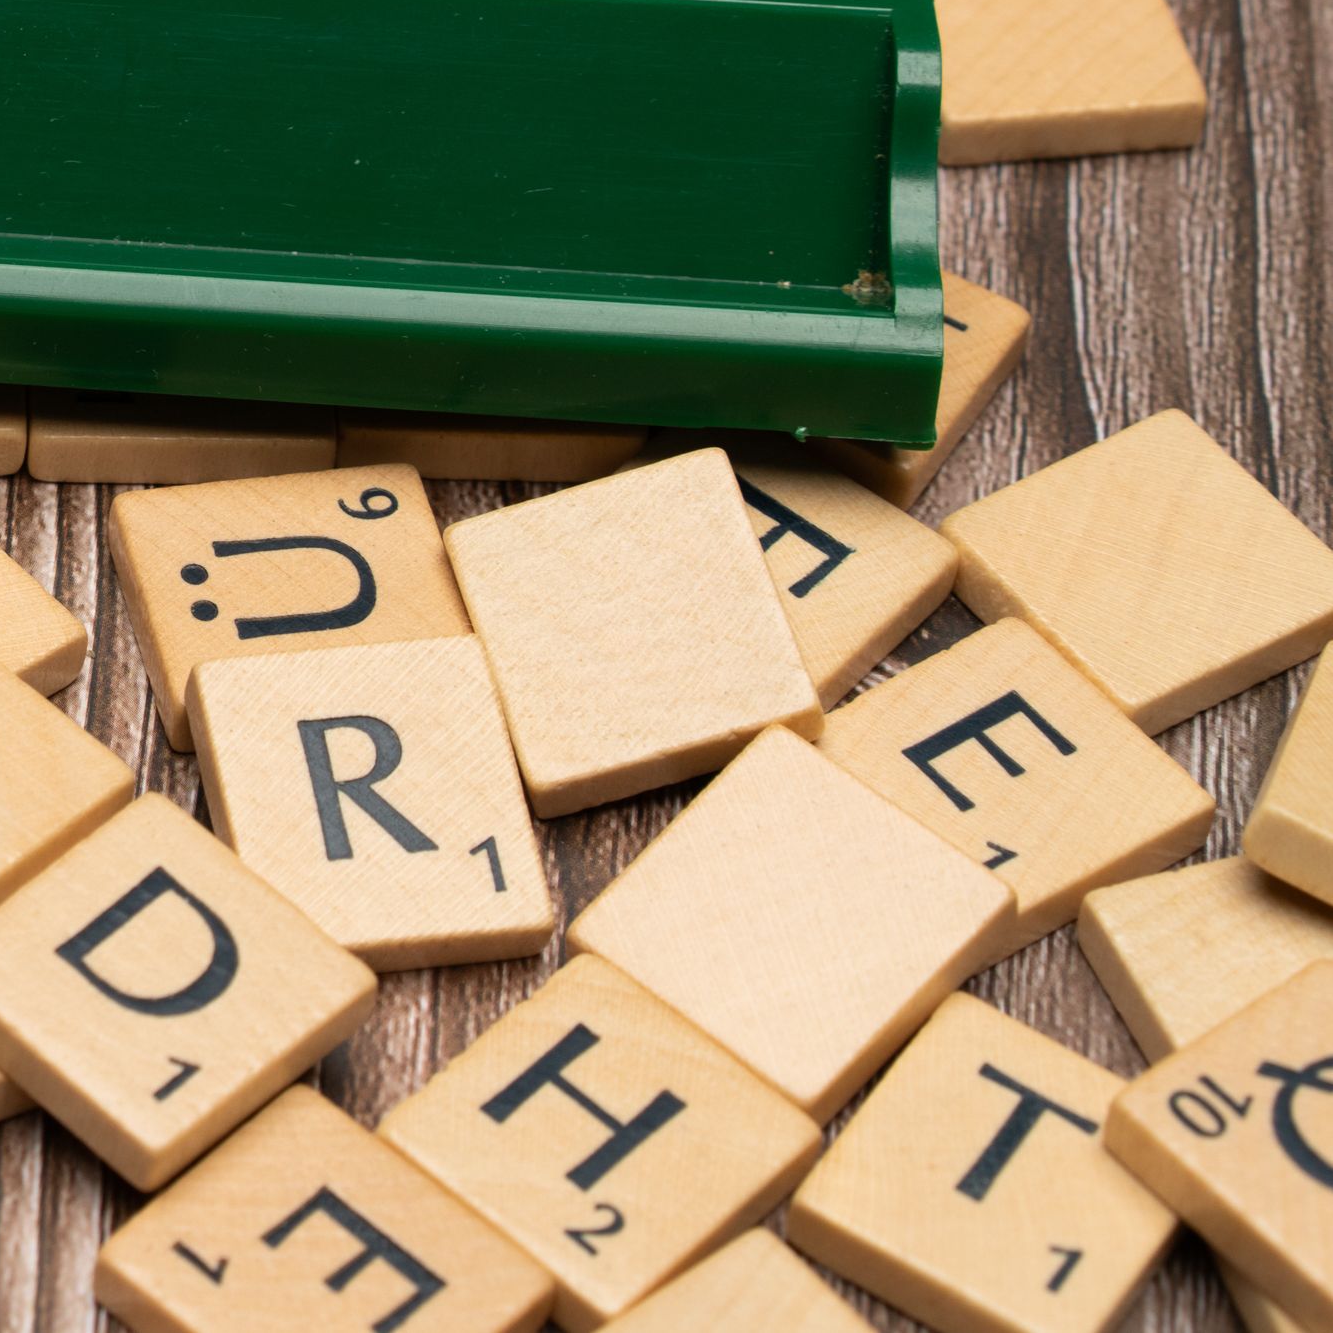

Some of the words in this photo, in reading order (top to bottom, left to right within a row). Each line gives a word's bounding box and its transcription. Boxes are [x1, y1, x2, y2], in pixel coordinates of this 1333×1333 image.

[181, 536, 376, 640] Ü
[338, 488, 398, 519] 6
[297, 715, 438, 861] R
[470, 836, 506, 892] 1
[902, 691, 1076, 811] E
[984, 842, 1017, 869] 1
[56, 867, 238, 1016] D
[154, 1059, 199, 1100] 1
[481, 1024, 686, 1191] H
[957, 1064, 1098, 1201] T
[1048, 1248, 1082, 1291] 1
[1169, 1076, 1252, 1137] 10
[174, 1243, 227, 1284] 1
[262, 1187, 446, 1333] E
[566, 1204, 624, 1255] 2
